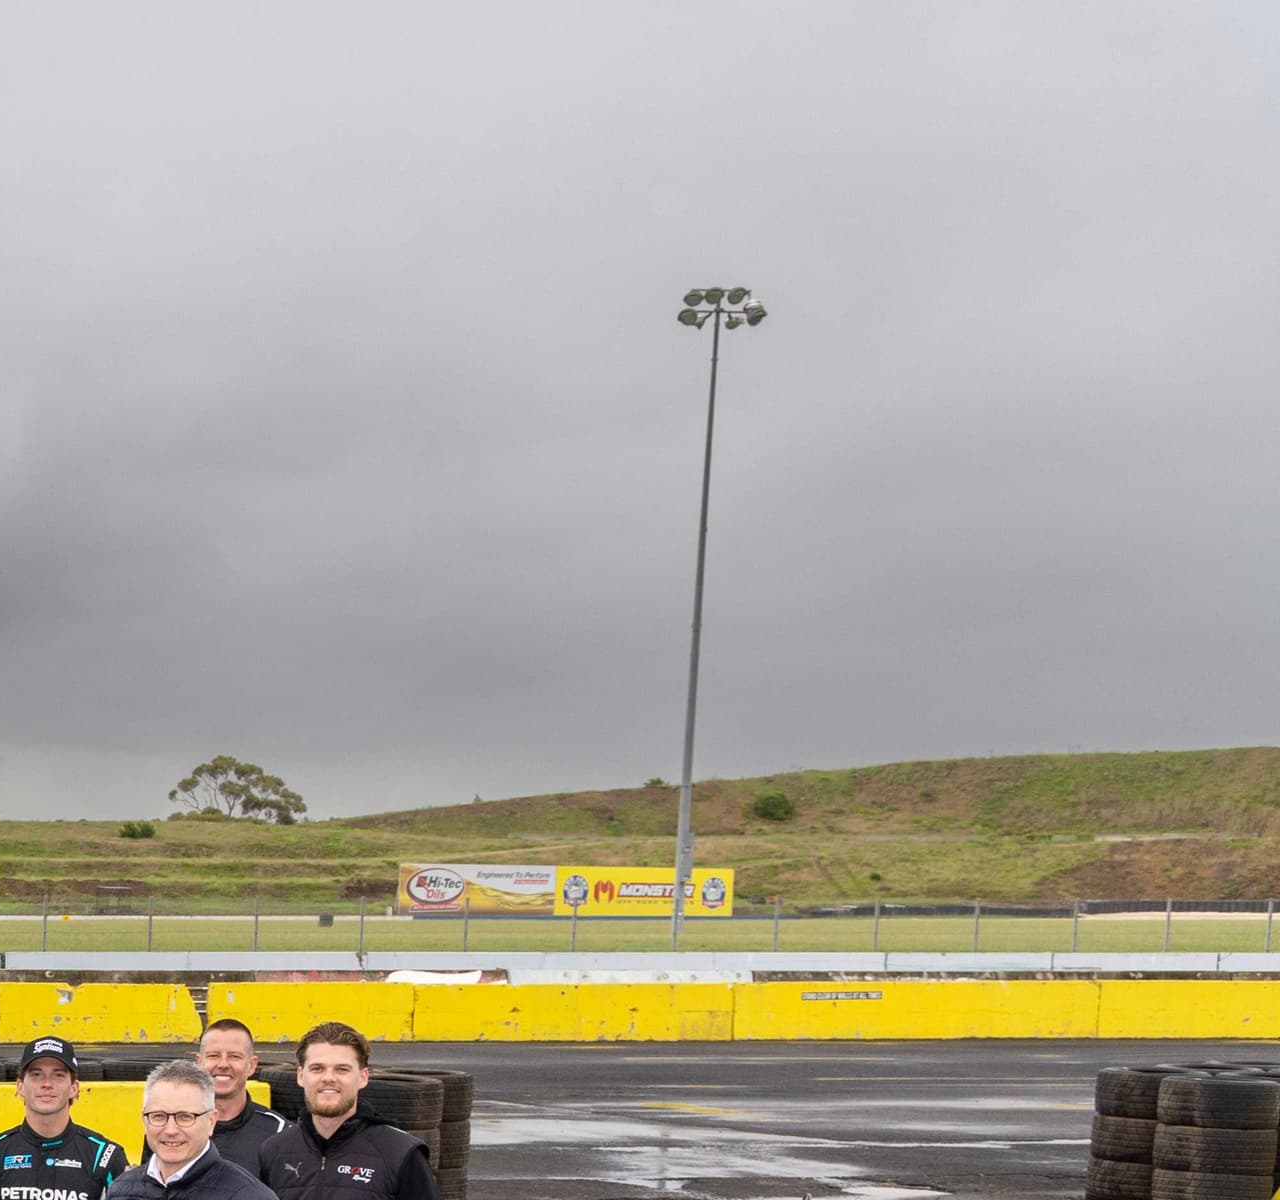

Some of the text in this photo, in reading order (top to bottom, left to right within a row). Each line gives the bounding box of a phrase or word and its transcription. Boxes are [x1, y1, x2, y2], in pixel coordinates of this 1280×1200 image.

[428, 875, 462, 889] Hi-Tec
[426, 890, 446, 899] Oils
[619, 884, 695, 897] MONSTR
[338, 1165, 375, 1178] GROVE
